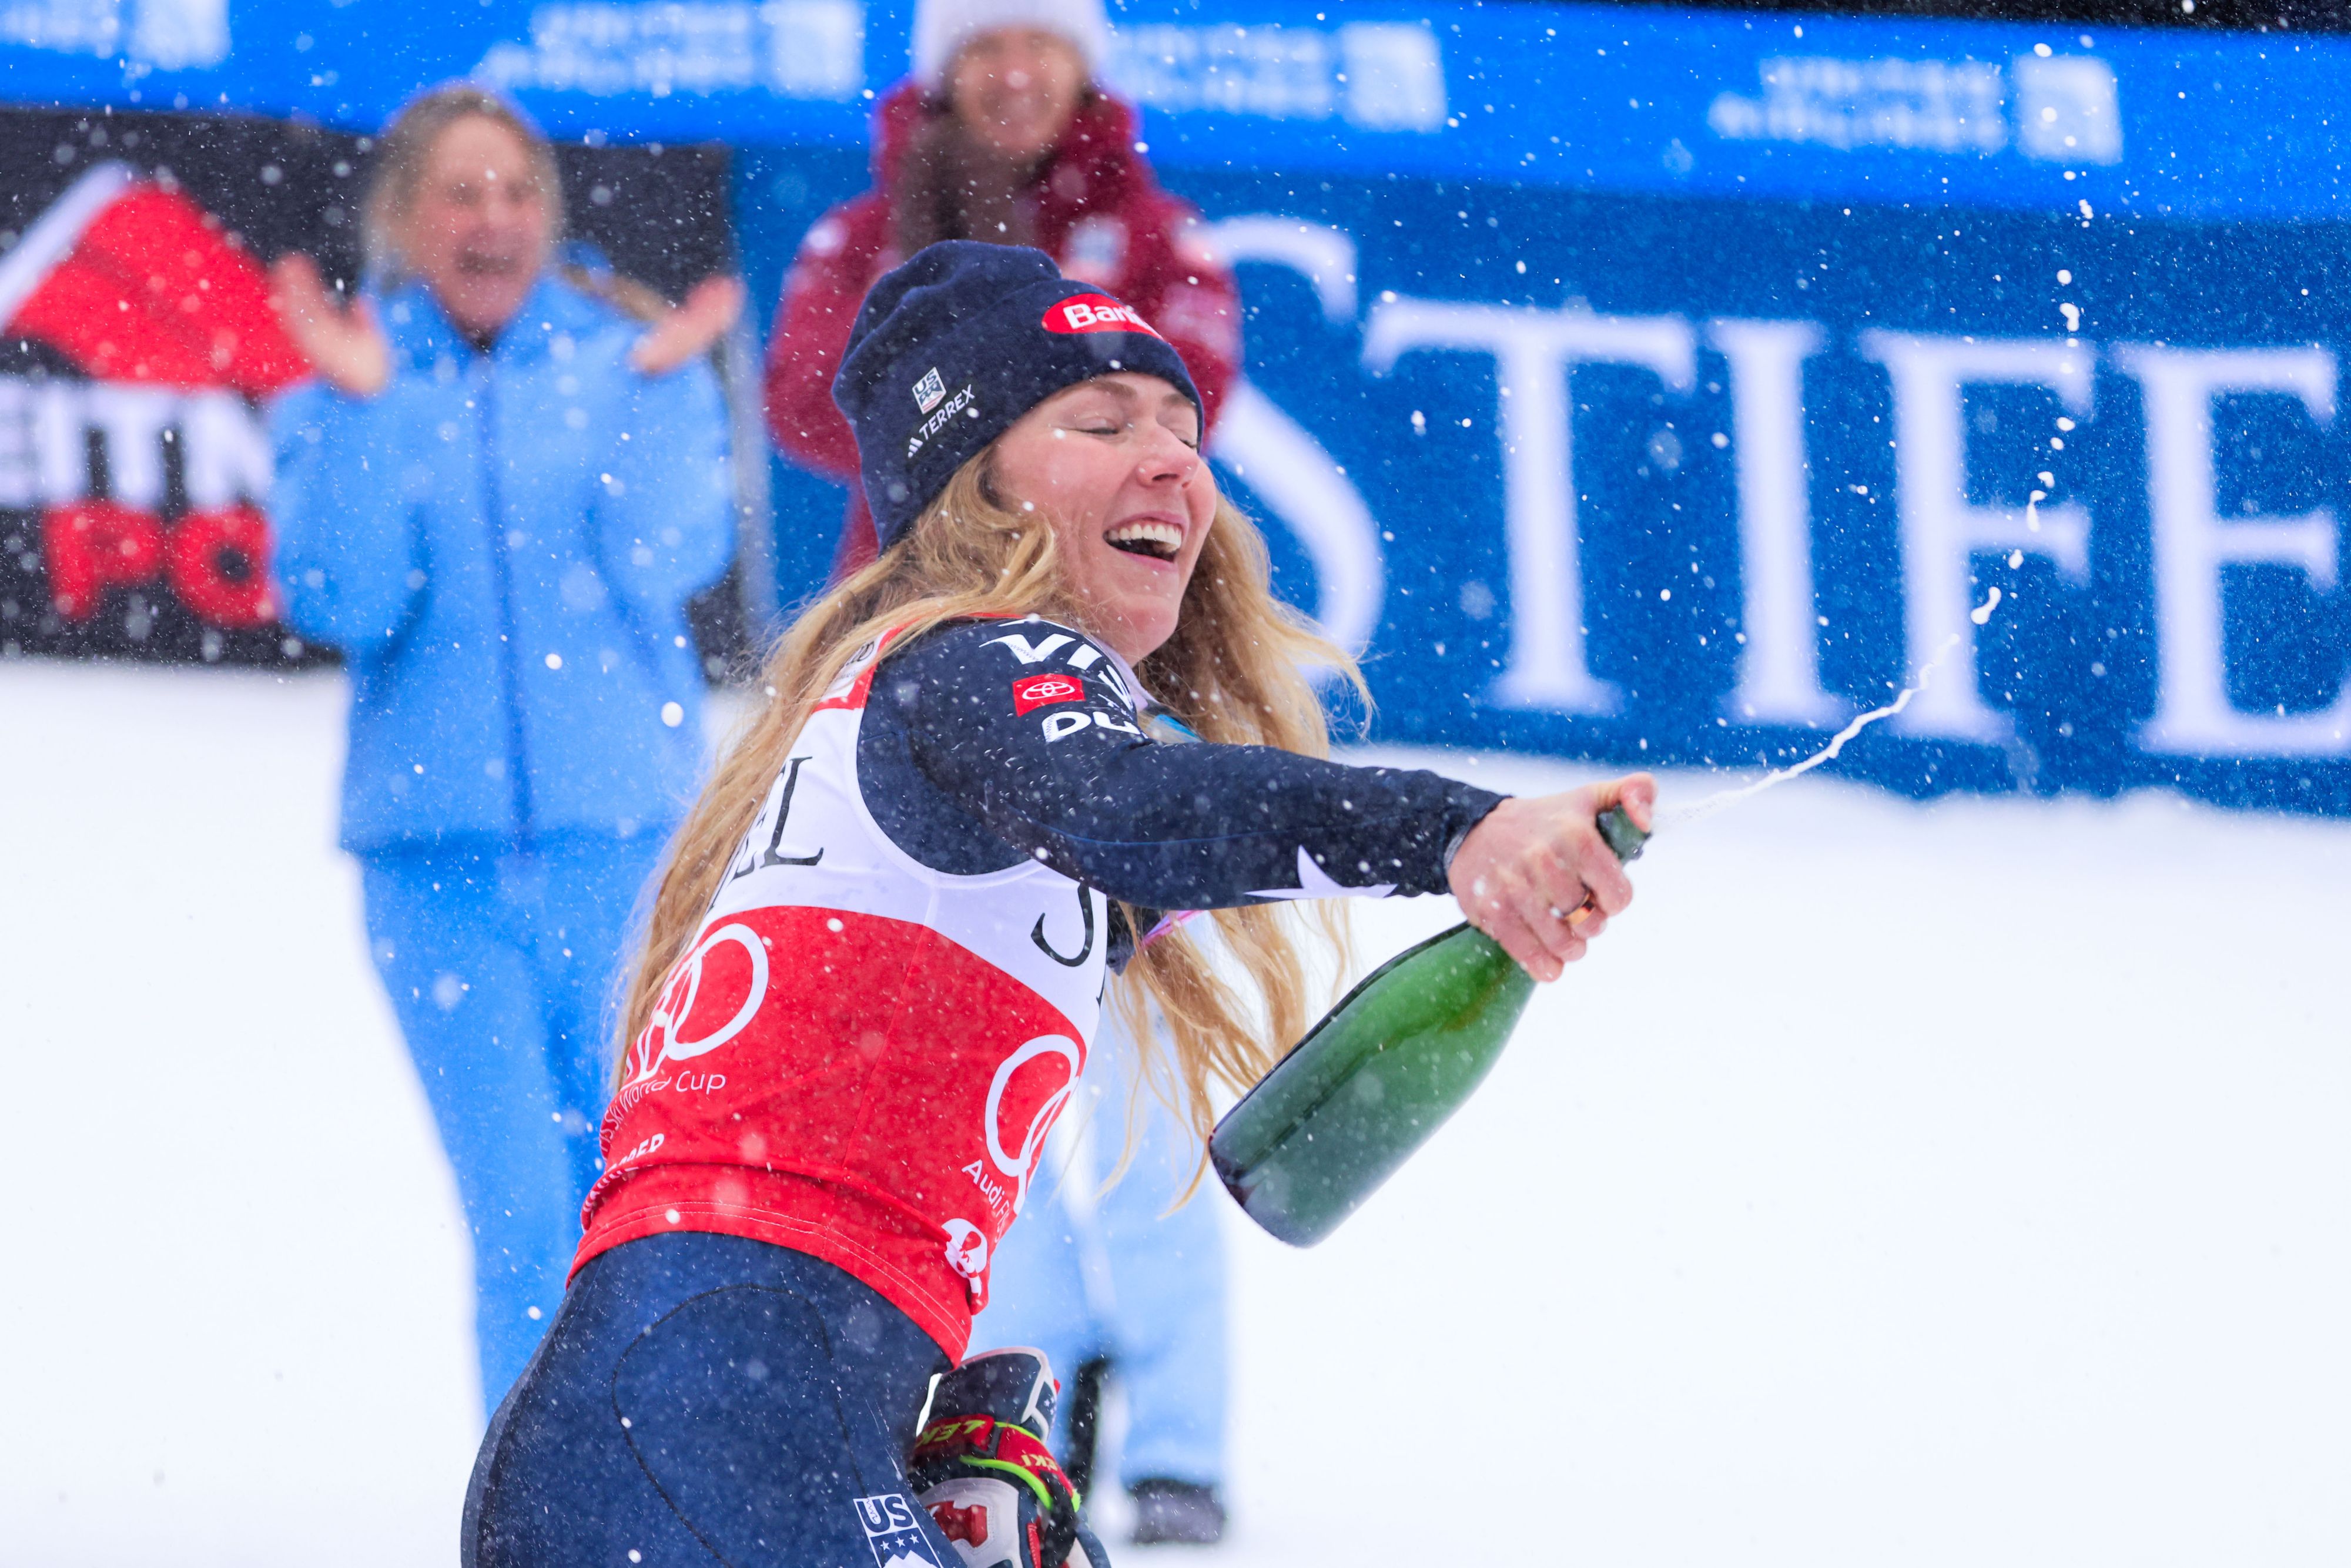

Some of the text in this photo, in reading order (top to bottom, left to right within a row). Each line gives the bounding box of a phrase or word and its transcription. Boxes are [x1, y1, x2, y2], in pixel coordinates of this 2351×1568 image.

[915, 371, 937, 394] US
[919, 384, 975, 440] TERREX
[619, 1076, 672, 1113] World
[676, 1071, 726, 1094] Cup
[961, 1159, 1005, 1209] Audi
[856, 1496, 913, 1533] US
